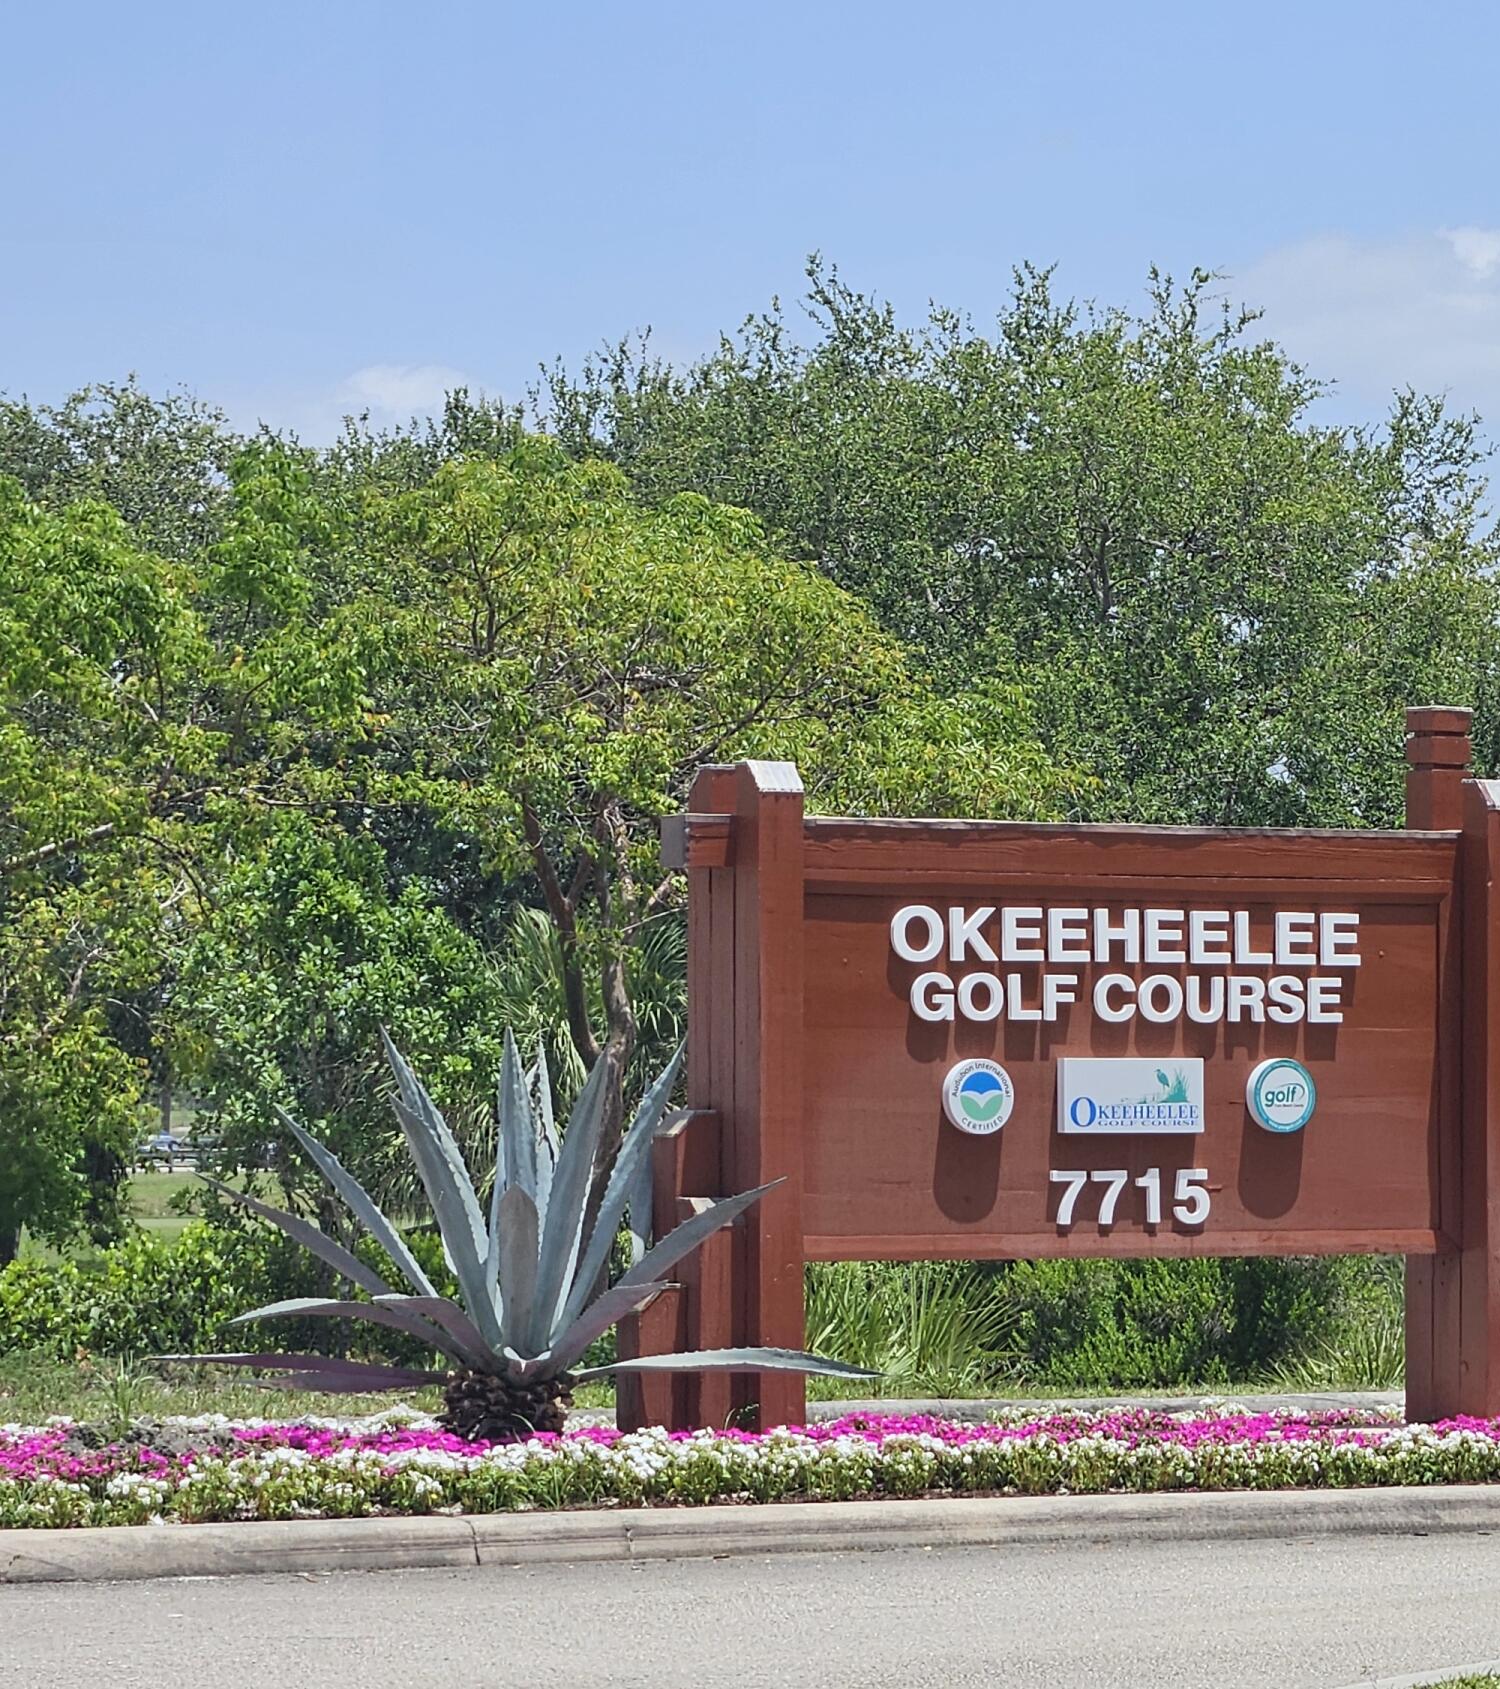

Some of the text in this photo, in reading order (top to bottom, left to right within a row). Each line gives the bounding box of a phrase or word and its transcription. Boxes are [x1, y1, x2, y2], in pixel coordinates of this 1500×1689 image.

[890, 905, 1361, 966] OKEEHEELEE
[910, 972, 1344, 1023] GOLF COURSE
[951, 1062, 1011, 1098] Audubon International
[1264, 1086, 1297, 1107] golf
[961, 1115, 1004, 1131] CERTIFIED
[1070, 1096, 1199, 1127] OKEEHEELEE
[1098, 1119, 1197, 1127] GOLF COURSE
[1049, 1168, 1211, 1225] 7715
